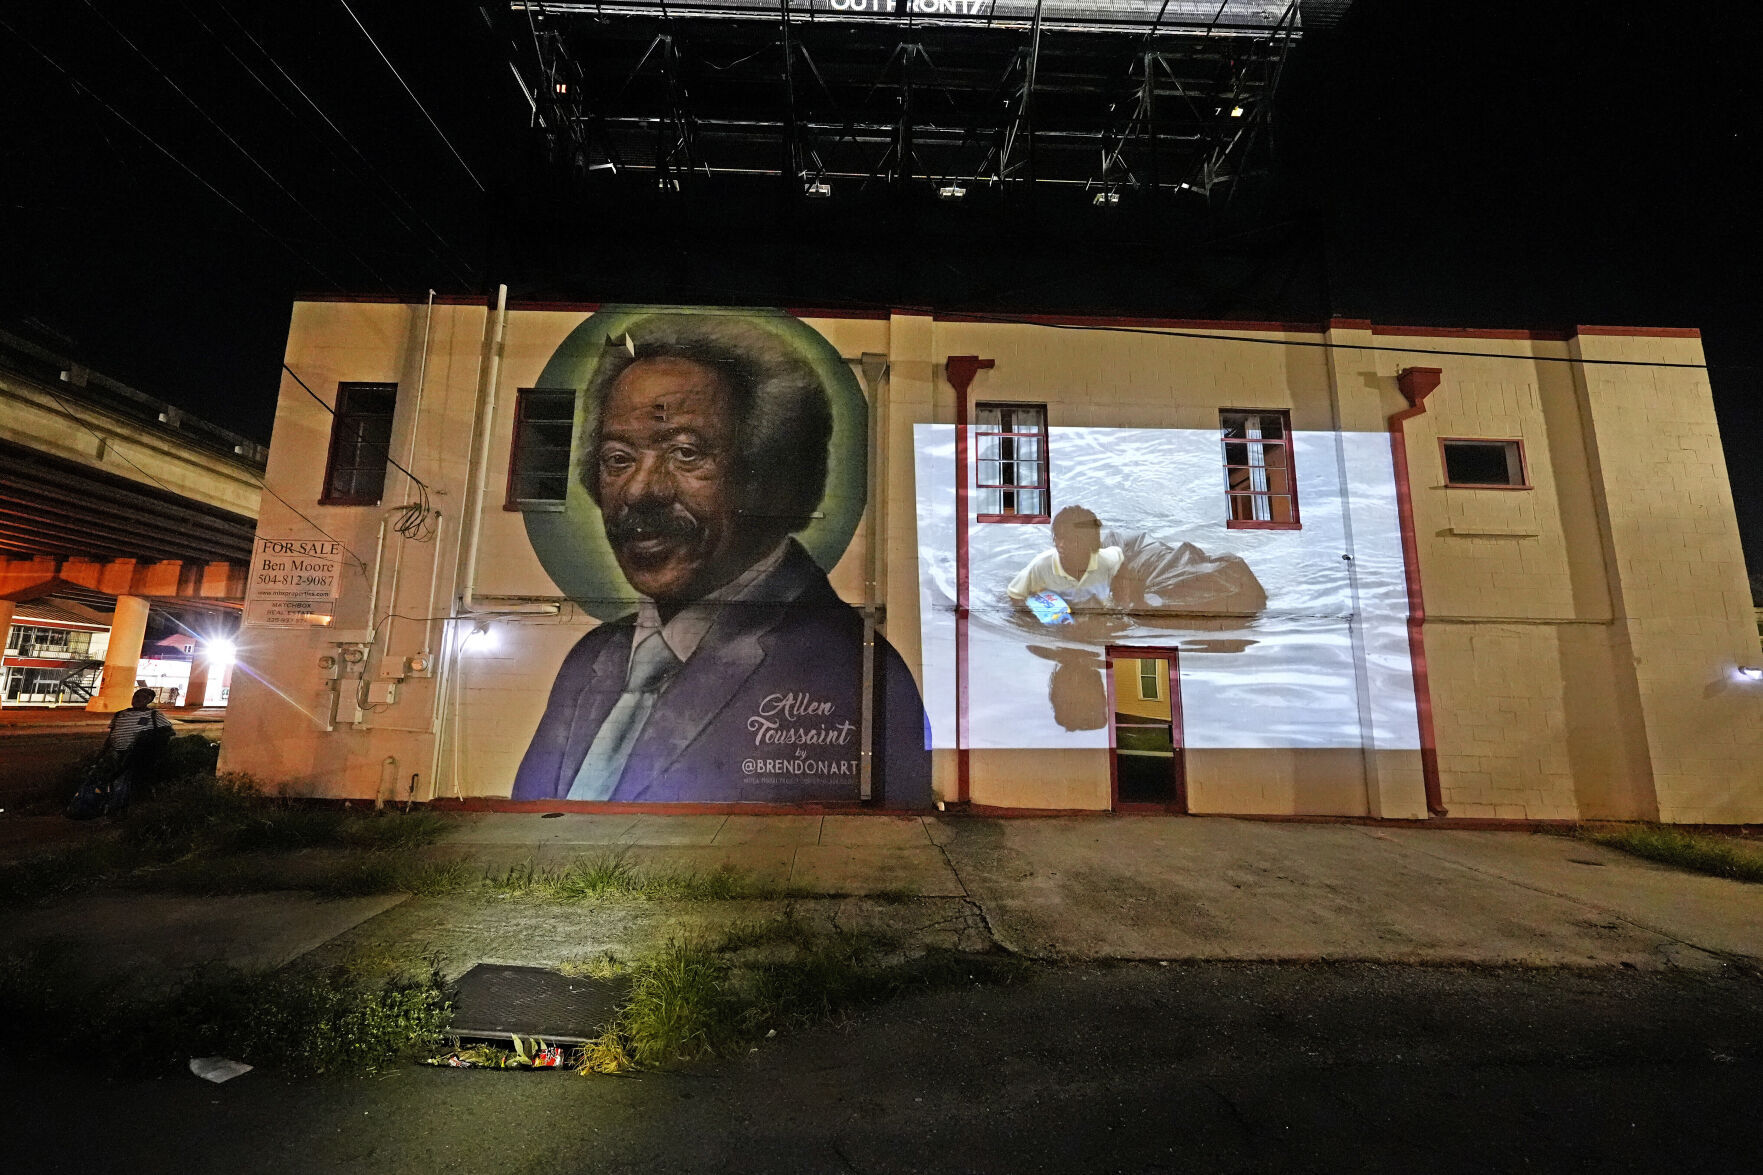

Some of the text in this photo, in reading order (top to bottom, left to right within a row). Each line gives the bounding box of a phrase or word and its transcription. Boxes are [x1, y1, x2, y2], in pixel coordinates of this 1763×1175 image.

[263, 541, 340, 555] FOR SALE
[262, 559, 334, 573] Ben Moore
[256, 574, 335, 587] 504-812-9087
[760, 692, 835, 721] Allen
[747, 716, 856, 746] Toussaint
[795, 748, 807, 760] by
[742, 758, 858, 775] @BRENDONART
